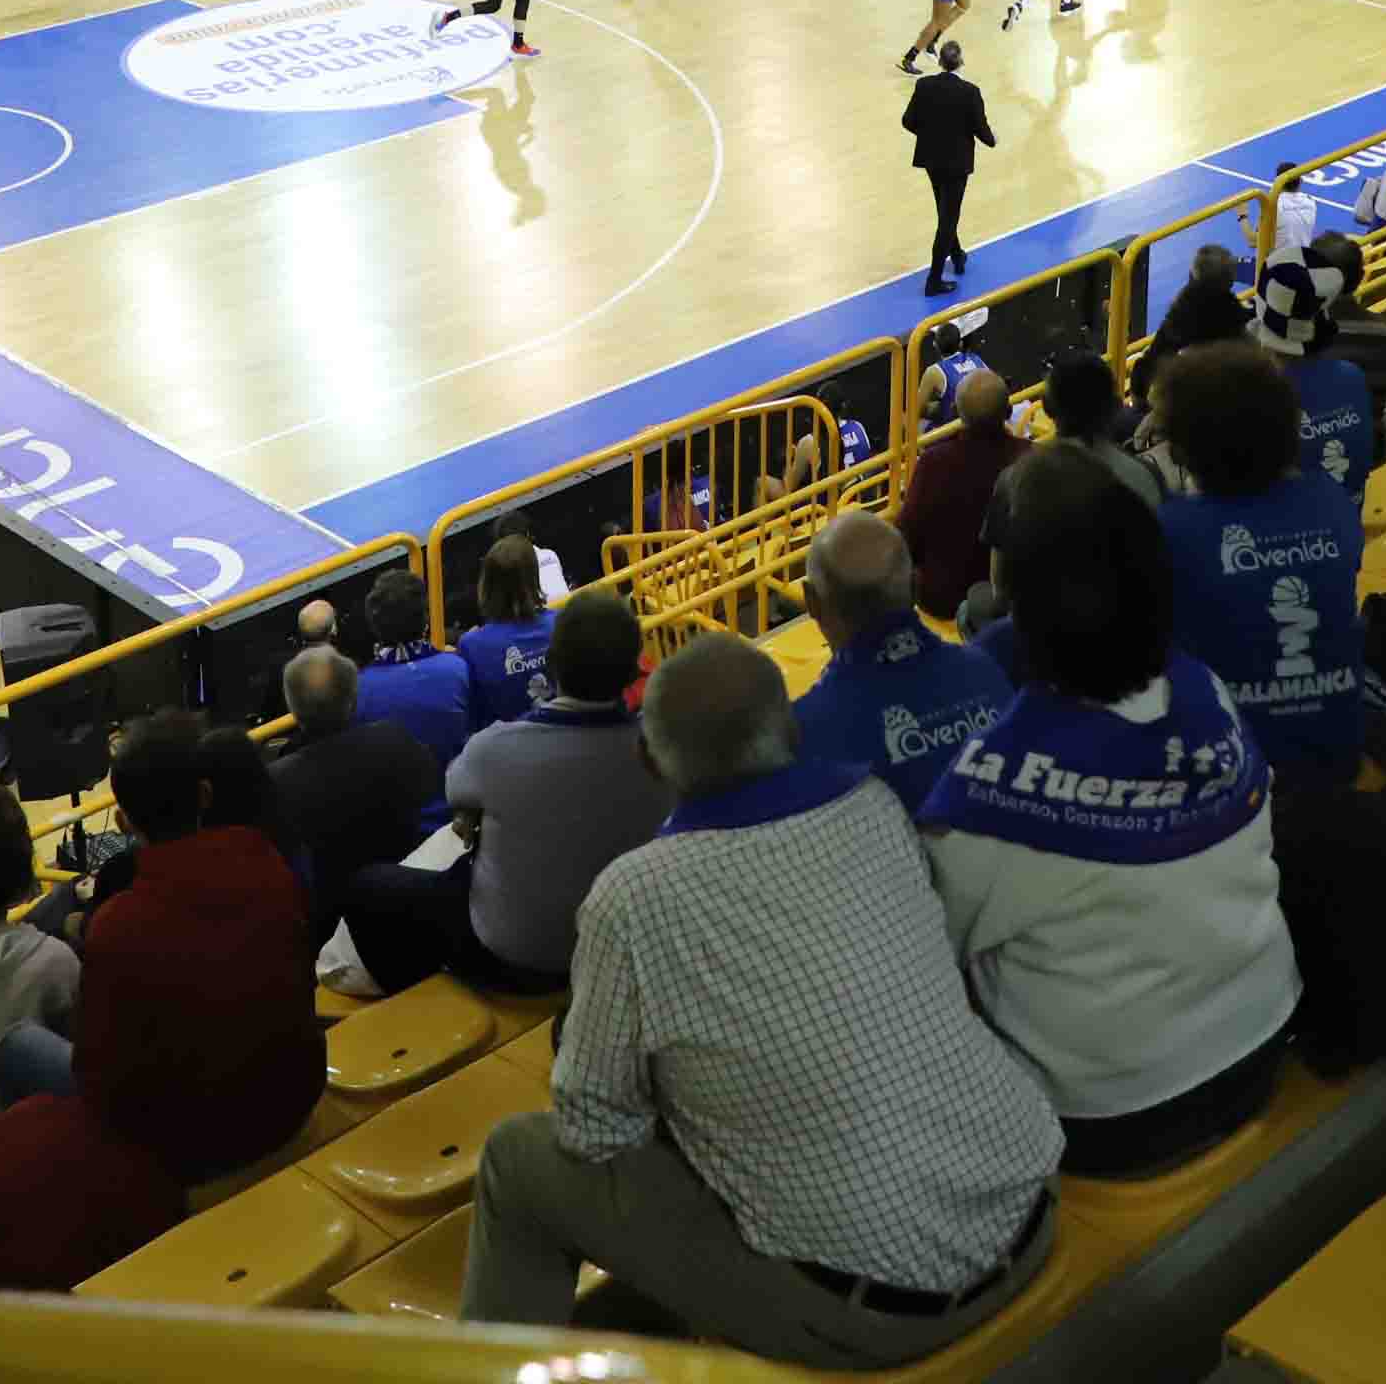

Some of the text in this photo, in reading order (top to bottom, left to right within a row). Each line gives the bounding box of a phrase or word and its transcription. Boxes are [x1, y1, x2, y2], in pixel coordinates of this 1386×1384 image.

[215, 22, 414, 75] avenida
[954, 738, 1188, 808] La Fuerza
